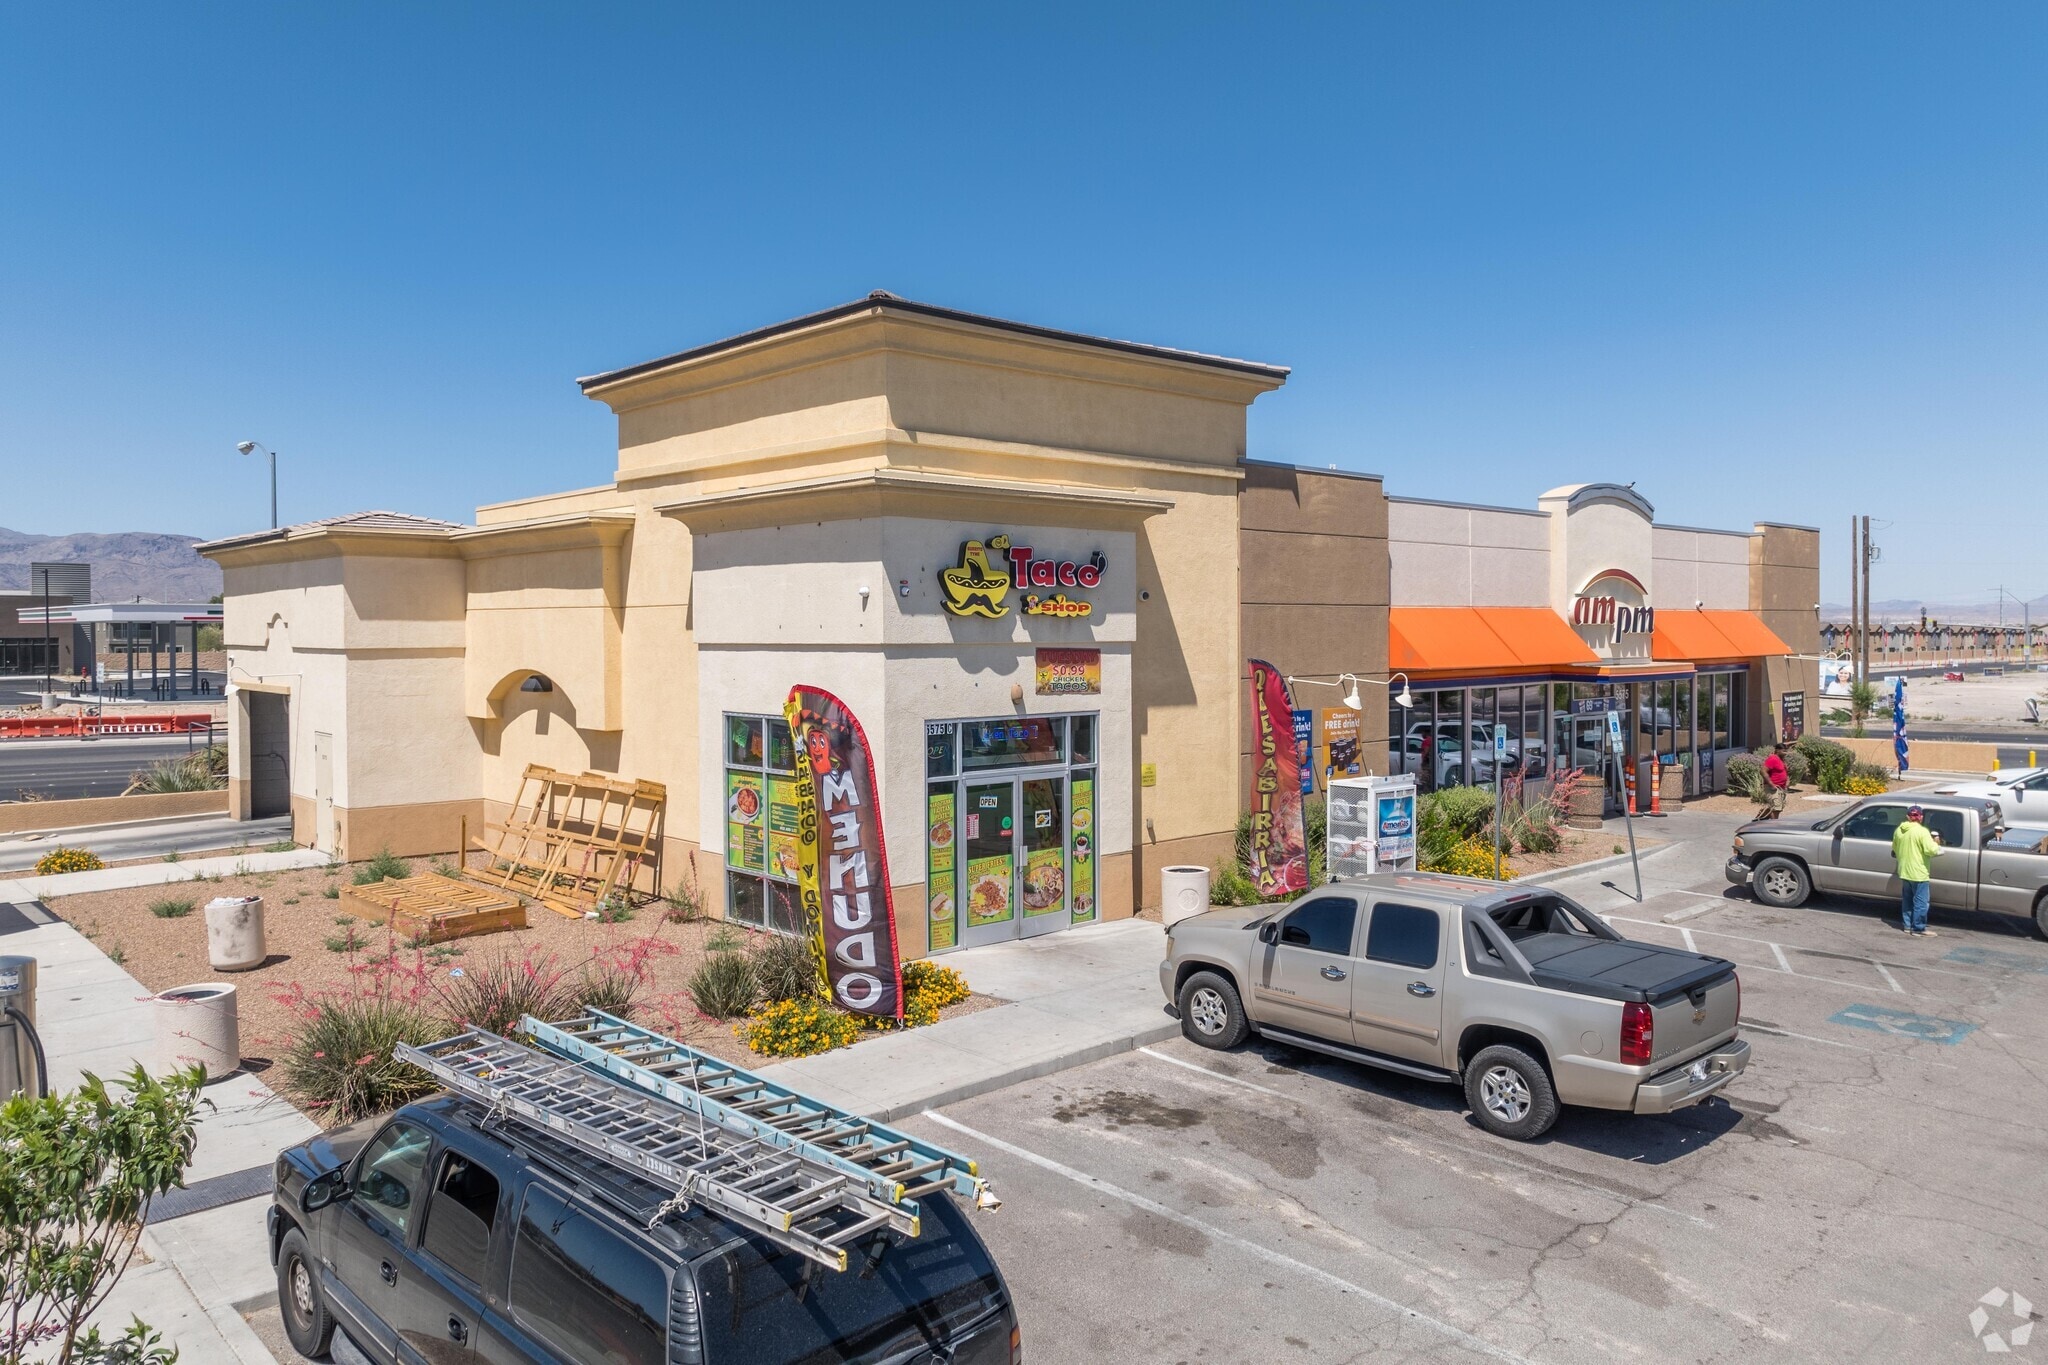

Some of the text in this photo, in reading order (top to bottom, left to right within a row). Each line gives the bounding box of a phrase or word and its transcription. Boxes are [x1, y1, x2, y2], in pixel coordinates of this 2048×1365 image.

[1010, 547, 1101, 589] Taco
[1041, 603, 1090, 612] SHOP
[1040, 650, 1096, 664] TUESDAY
[1053, 665, 1085, 675] $0.99
[1051, 682, 1087, 691] TACOS
[1296, 722, 1311, 732] rink!
[1325, 719, 1360, 729] FREE drink!
[980, 798, 996, 806] OPEN
[1382, 820, 1409, 830] AmeriGas
[968, 857, 1004, 873] SUPER FRIES
